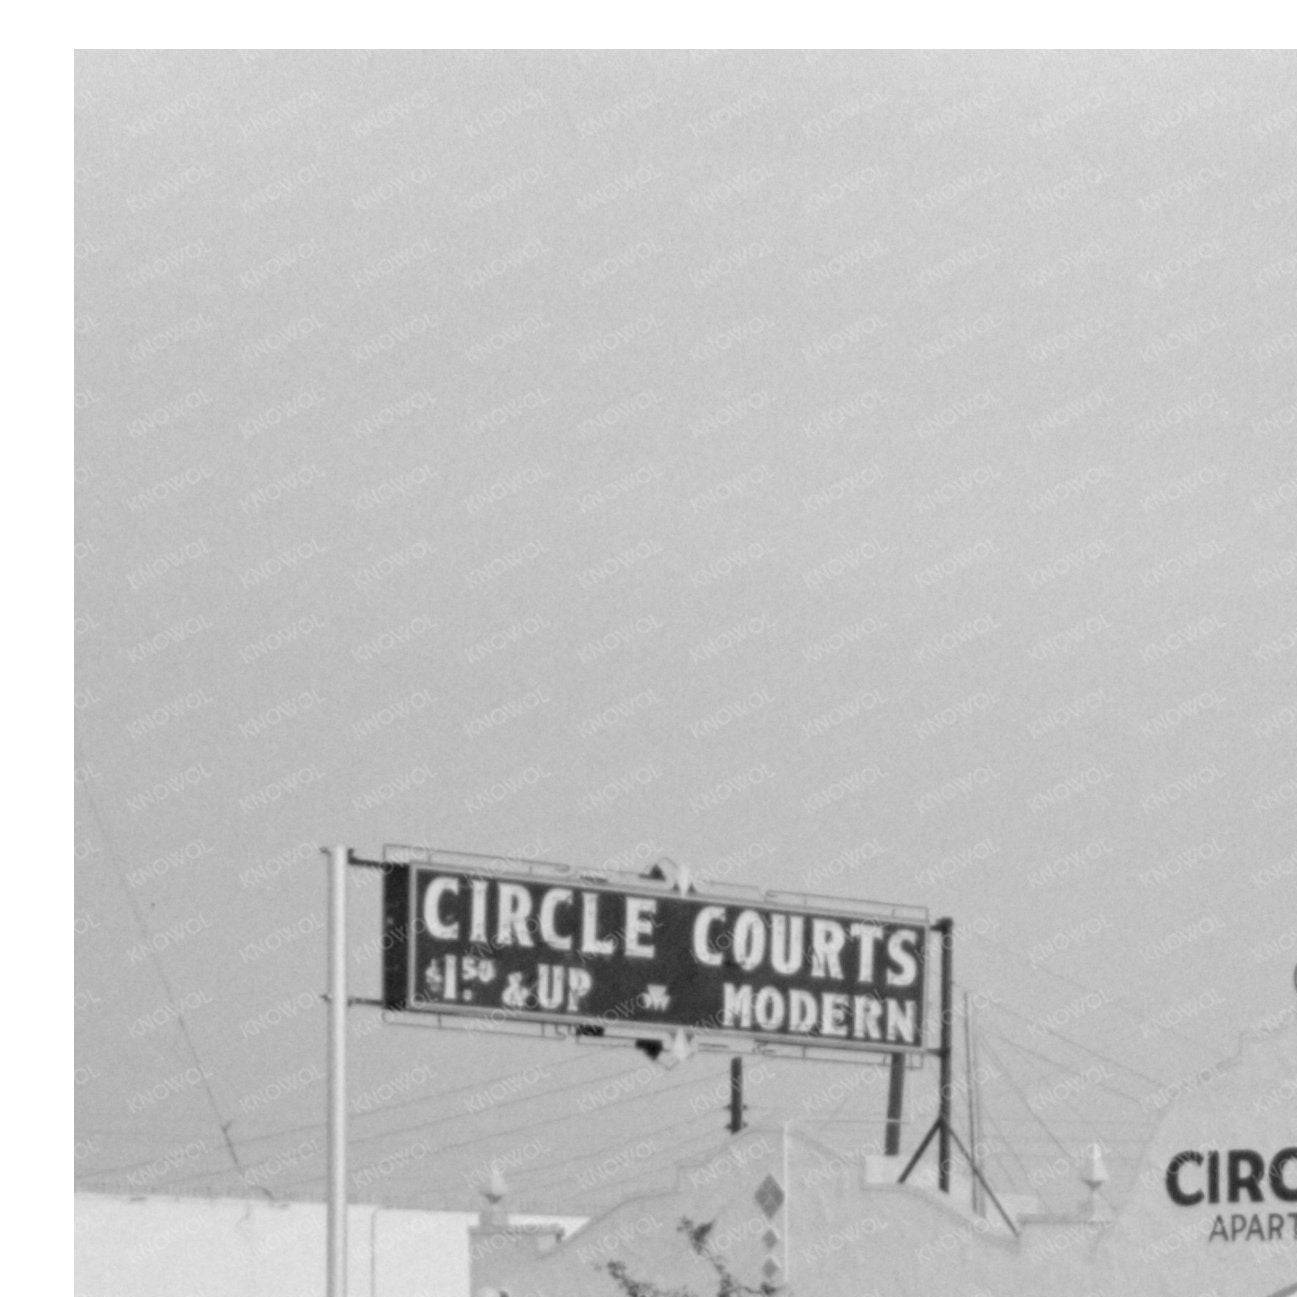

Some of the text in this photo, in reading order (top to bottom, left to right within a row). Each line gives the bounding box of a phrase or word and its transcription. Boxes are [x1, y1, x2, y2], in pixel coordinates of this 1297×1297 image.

[423, 876, 917, 988] CIRCLE COURTS
[502, 970, 529, 1008] &
[537, 963, 593, 1013] UP
[722, 982, 917, 1043] MODERN
